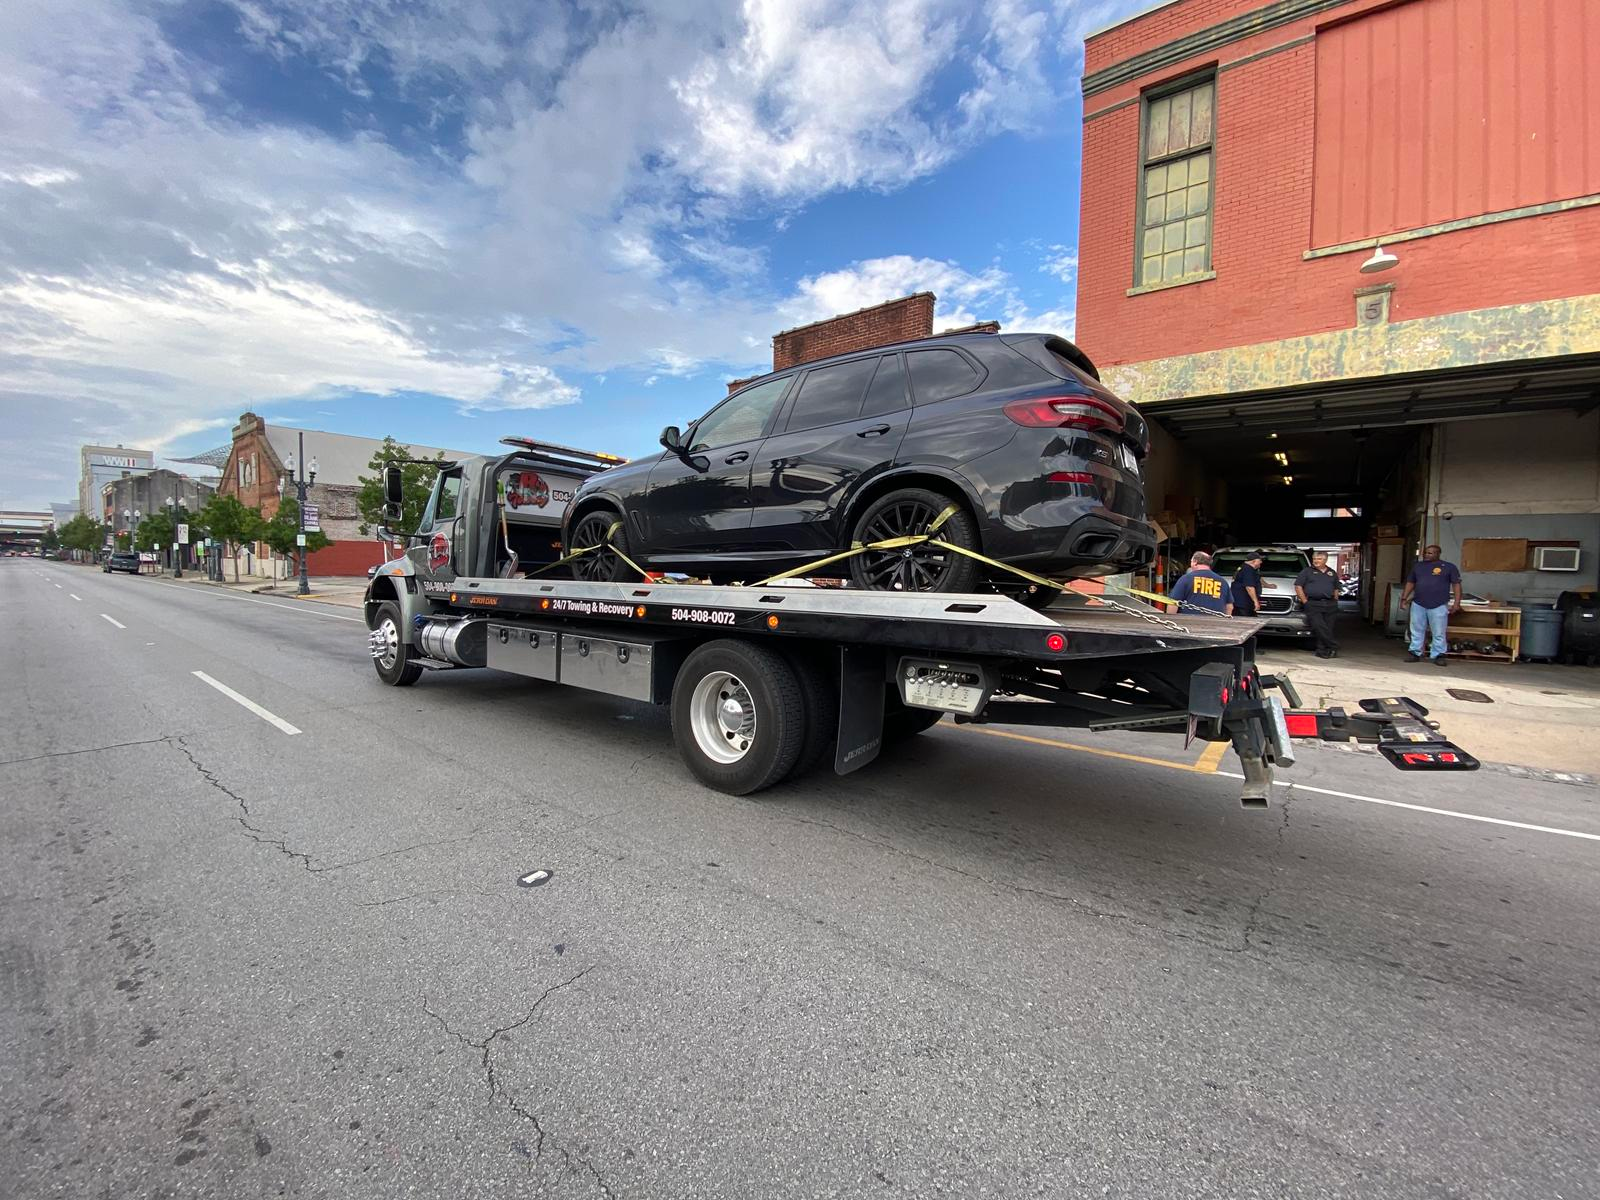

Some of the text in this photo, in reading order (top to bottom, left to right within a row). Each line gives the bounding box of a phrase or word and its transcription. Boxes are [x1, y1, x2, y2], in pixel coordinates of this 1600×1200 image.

[1365, 302, 1381, 320] 5
[103, 456, 136, 467] WWII
[1193, 577, 1222, 597] FIRE
[553, 600, 634, 618] 24/7 Towing & Recovery
[671, 608, 735, 625] 504-908-0072
